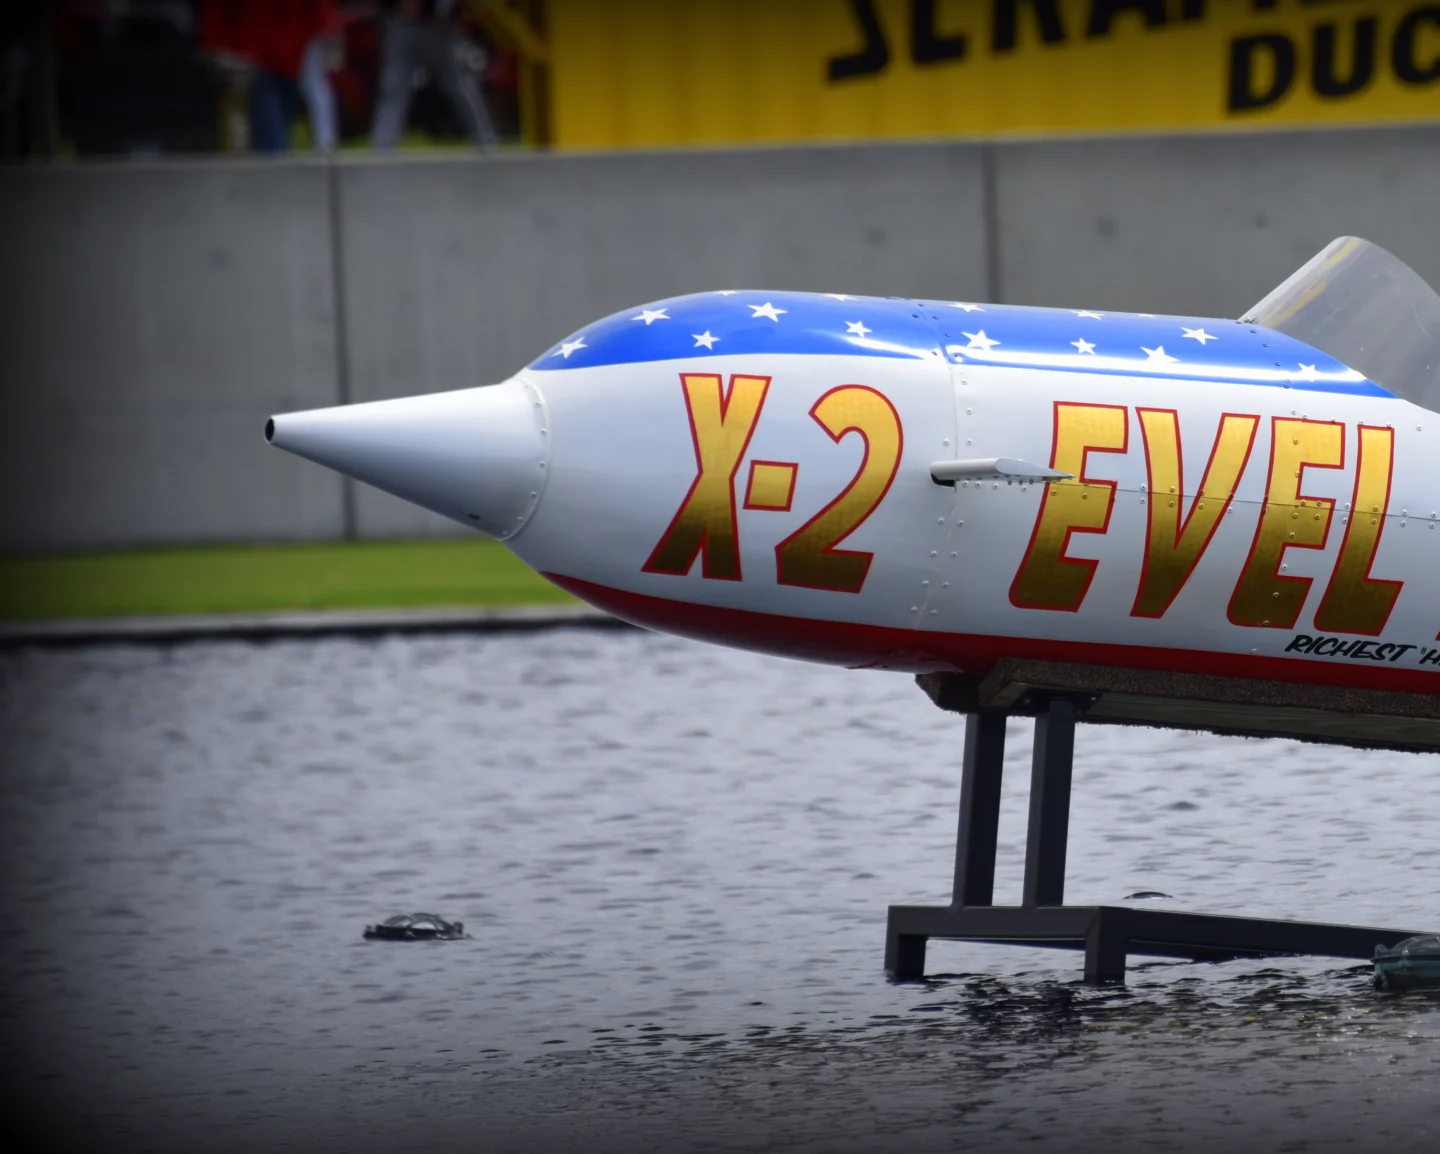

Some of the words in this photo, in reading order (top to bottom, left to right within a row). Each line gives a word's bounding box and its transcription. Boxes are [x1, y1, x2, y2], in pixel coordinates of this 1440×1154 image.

[641, 372, 904, 595] X-2
[1008, 401, 1405, 636] EVEL
[1284, 634, 1418, 663] RICHEST
